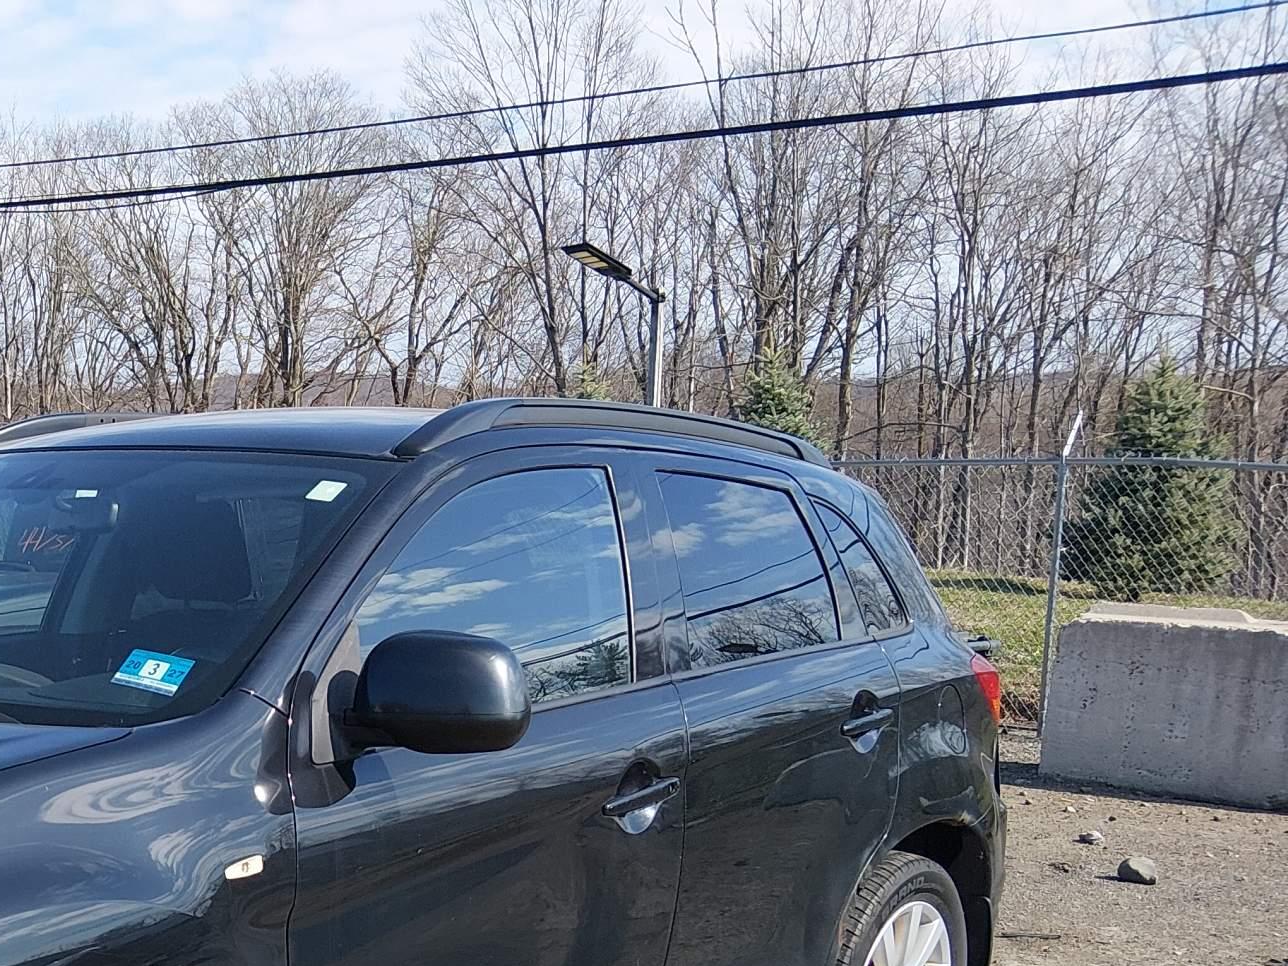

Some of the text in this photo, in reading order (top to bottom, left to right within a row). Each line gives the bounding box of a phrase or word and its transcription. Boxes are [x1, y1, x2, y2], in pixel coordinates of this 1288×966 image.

[125, 660, 186, 680] 20 3 27
